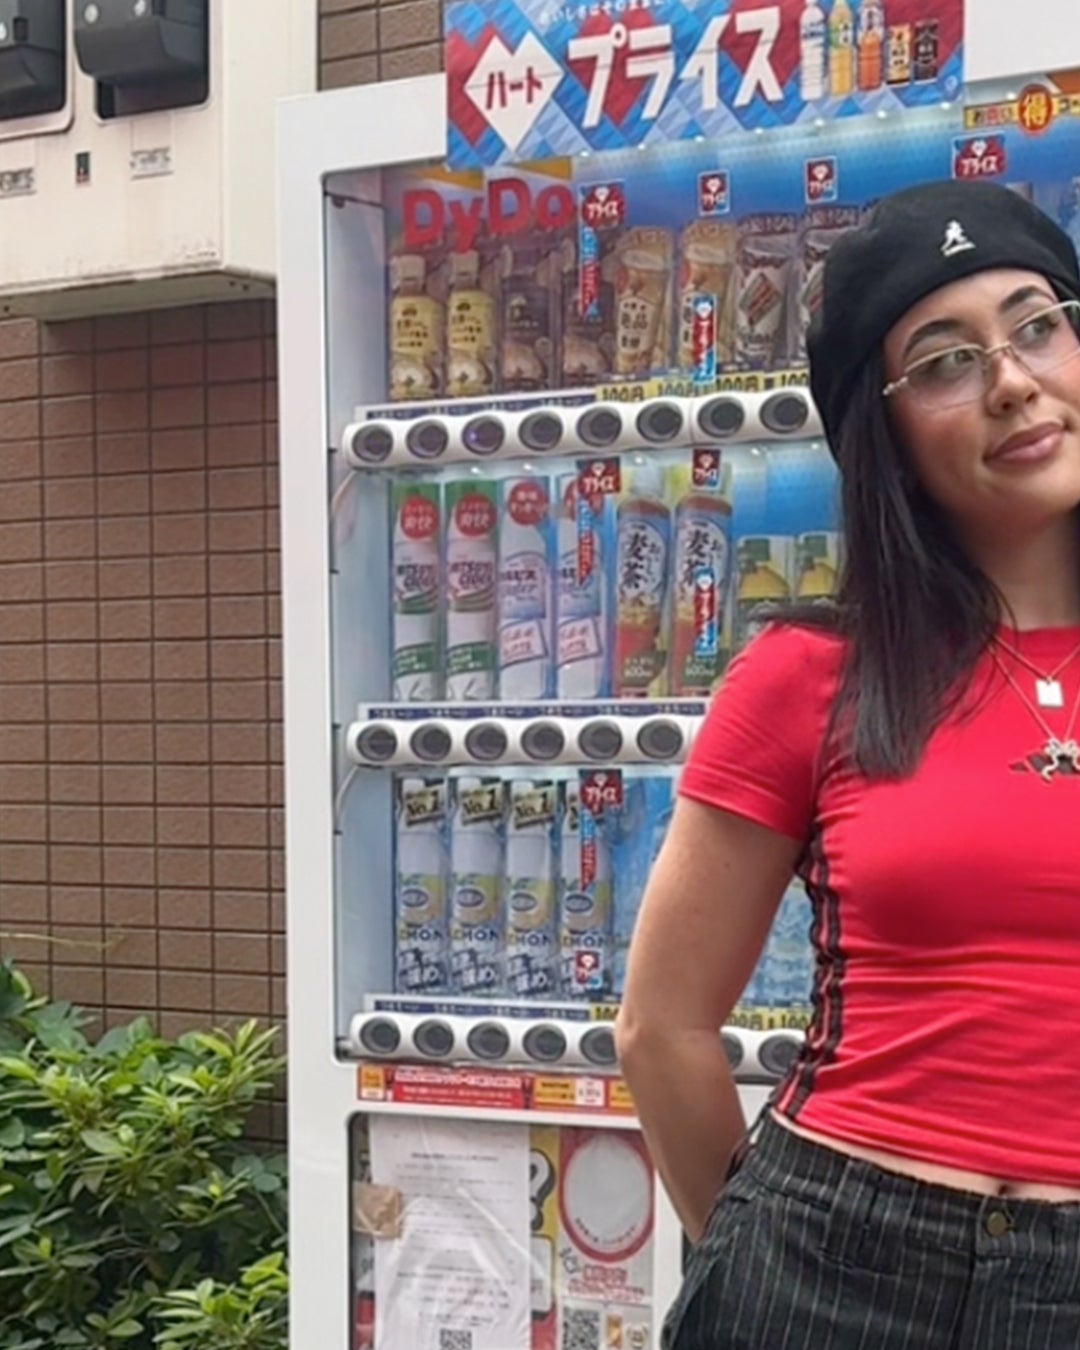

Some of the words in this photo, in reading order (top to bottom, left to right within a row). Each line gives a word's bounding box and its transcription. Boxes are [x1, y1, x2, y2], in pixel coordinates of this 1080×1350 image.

[485, 69, 543, 110] ハート
[567, 6, 784, 129] プライス
[402, 177, 572, 254] DyDo
[621, 531, 648, 590] 麦茶
